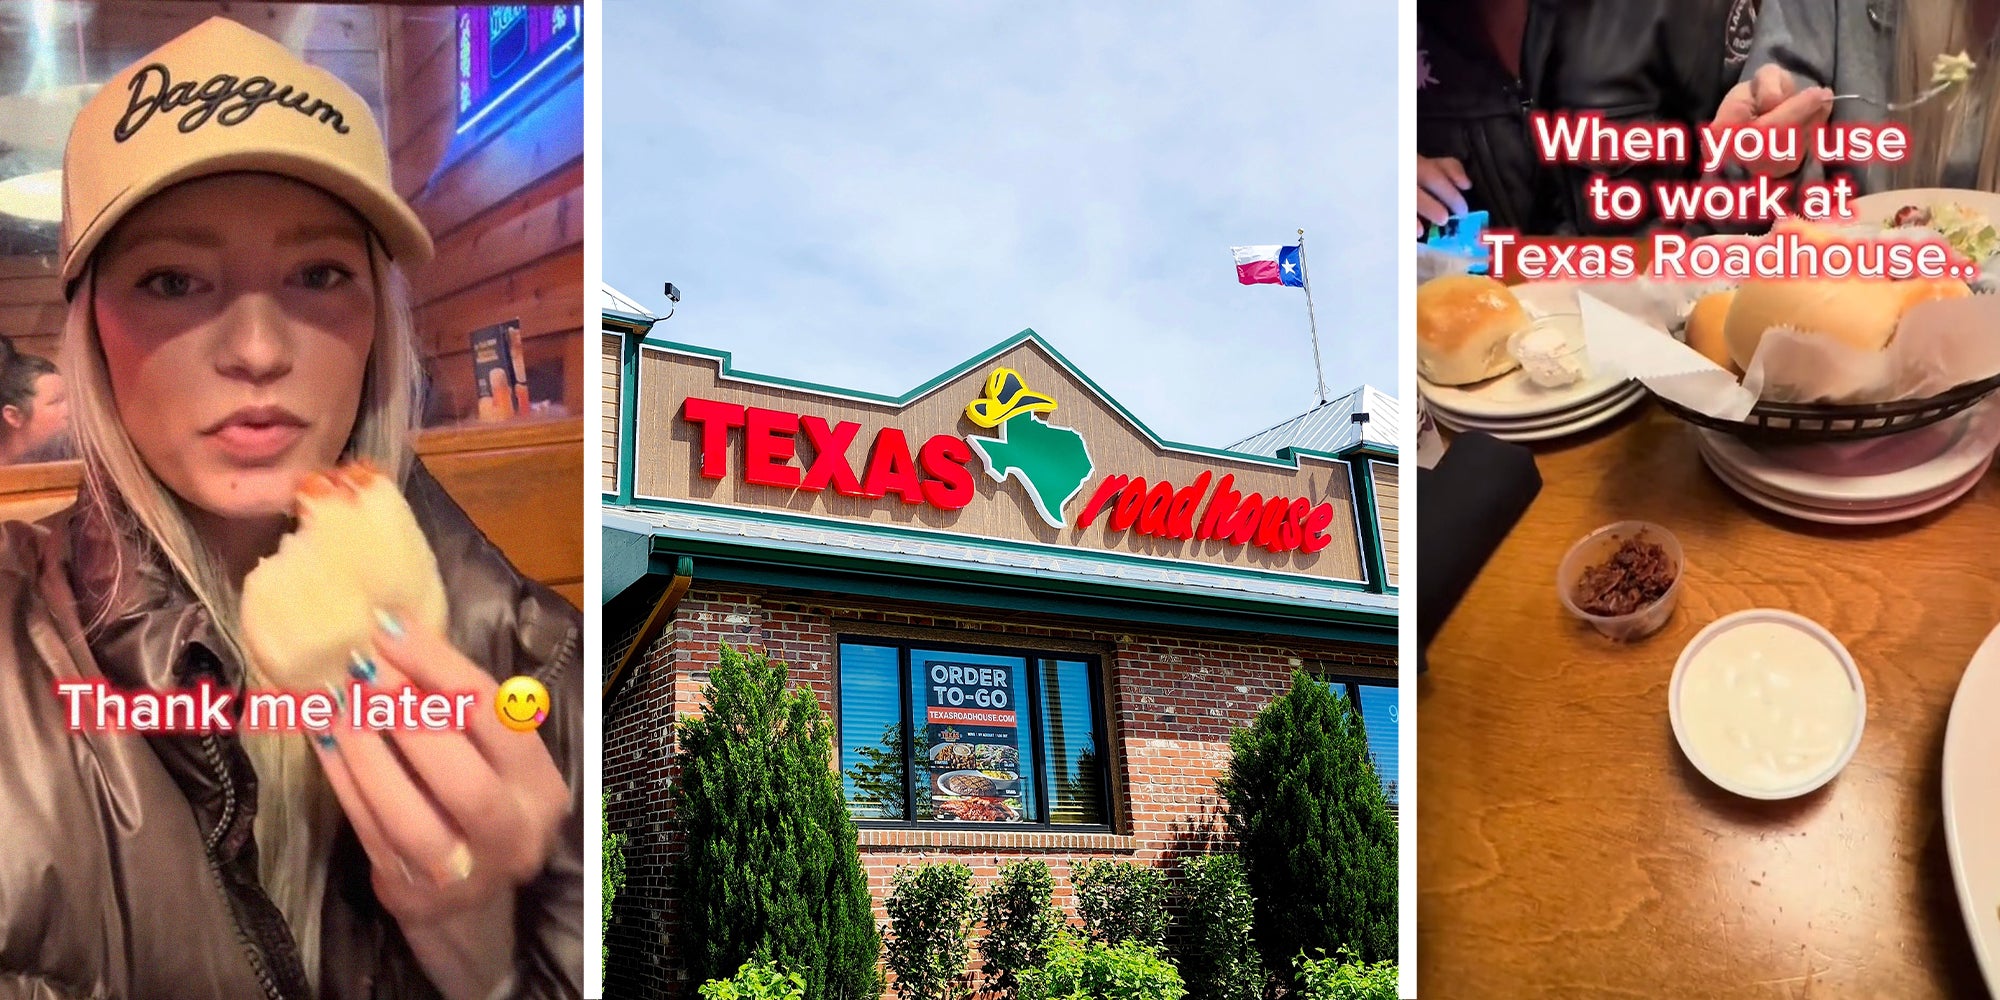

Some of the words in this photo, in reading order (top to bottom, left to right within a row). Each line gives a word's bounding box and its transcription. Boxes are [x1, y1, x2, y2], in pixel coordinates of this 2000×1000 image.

[114, 62, 350, 143] Daggum
[684, 397, 976, 511] TEXAS
[931, 665, 1008, 688] ORDER
[933, 686, 1007, 708] TO-GO
[929, 710, 1015, 722] TEXASROADHOUSE.COM
